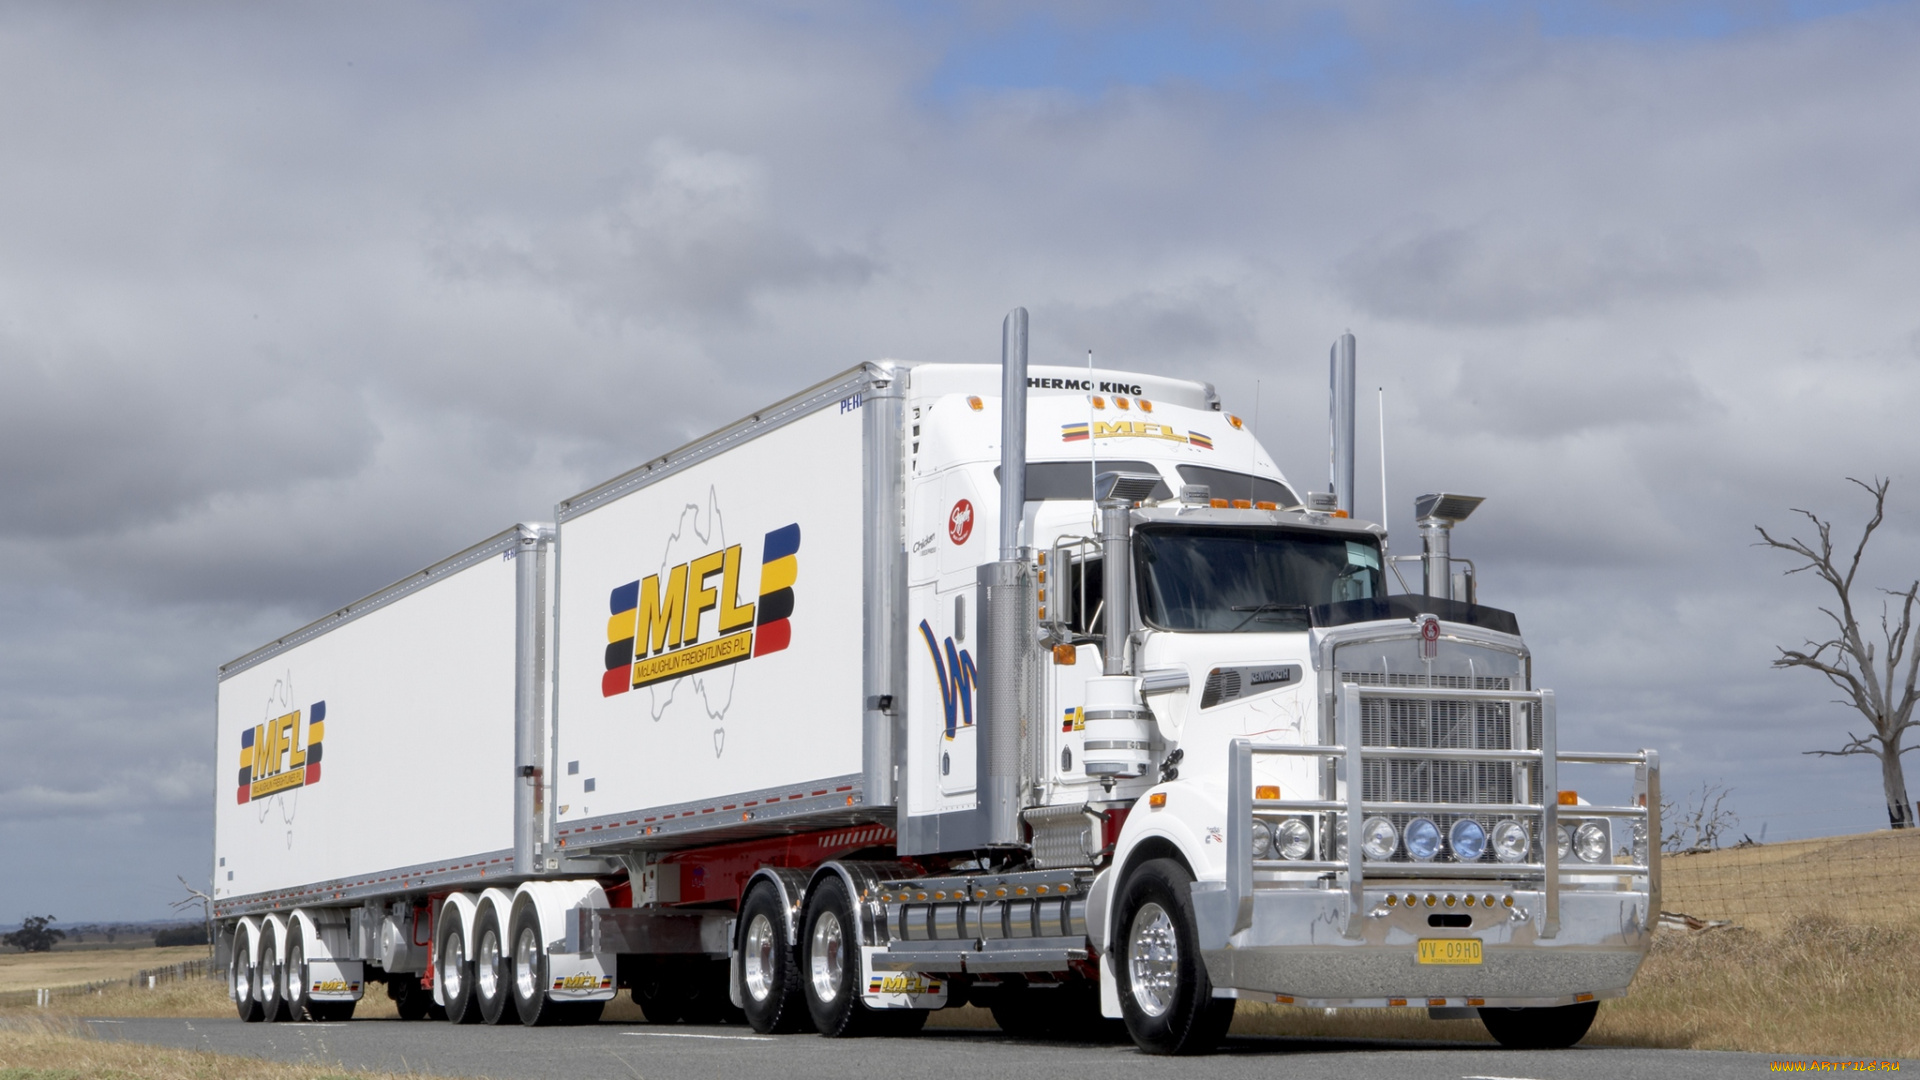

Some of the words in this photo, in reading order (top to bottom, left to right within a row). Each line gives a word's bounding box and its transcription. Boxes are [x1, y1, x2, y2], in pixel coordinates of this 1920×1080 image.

[1027, 377, 1095, 391] HERMO
[1099, 381, 1142, 396] KING
[1093, 421, 1188, 440] MFL
[635, 543, 756, 660] MFL
[636, 657, 679, 679] McLAUGHLIN
[680, 641, 732, 667] FREIGHTLINES
[1250, 668, 1290, 685] KENWORTH
[252, 709, 306, 781] MFL
[321, 981, 350, 990] MFL
[563, 976, 600, 987] MFL
[882, 976, 927, 989] MFL
